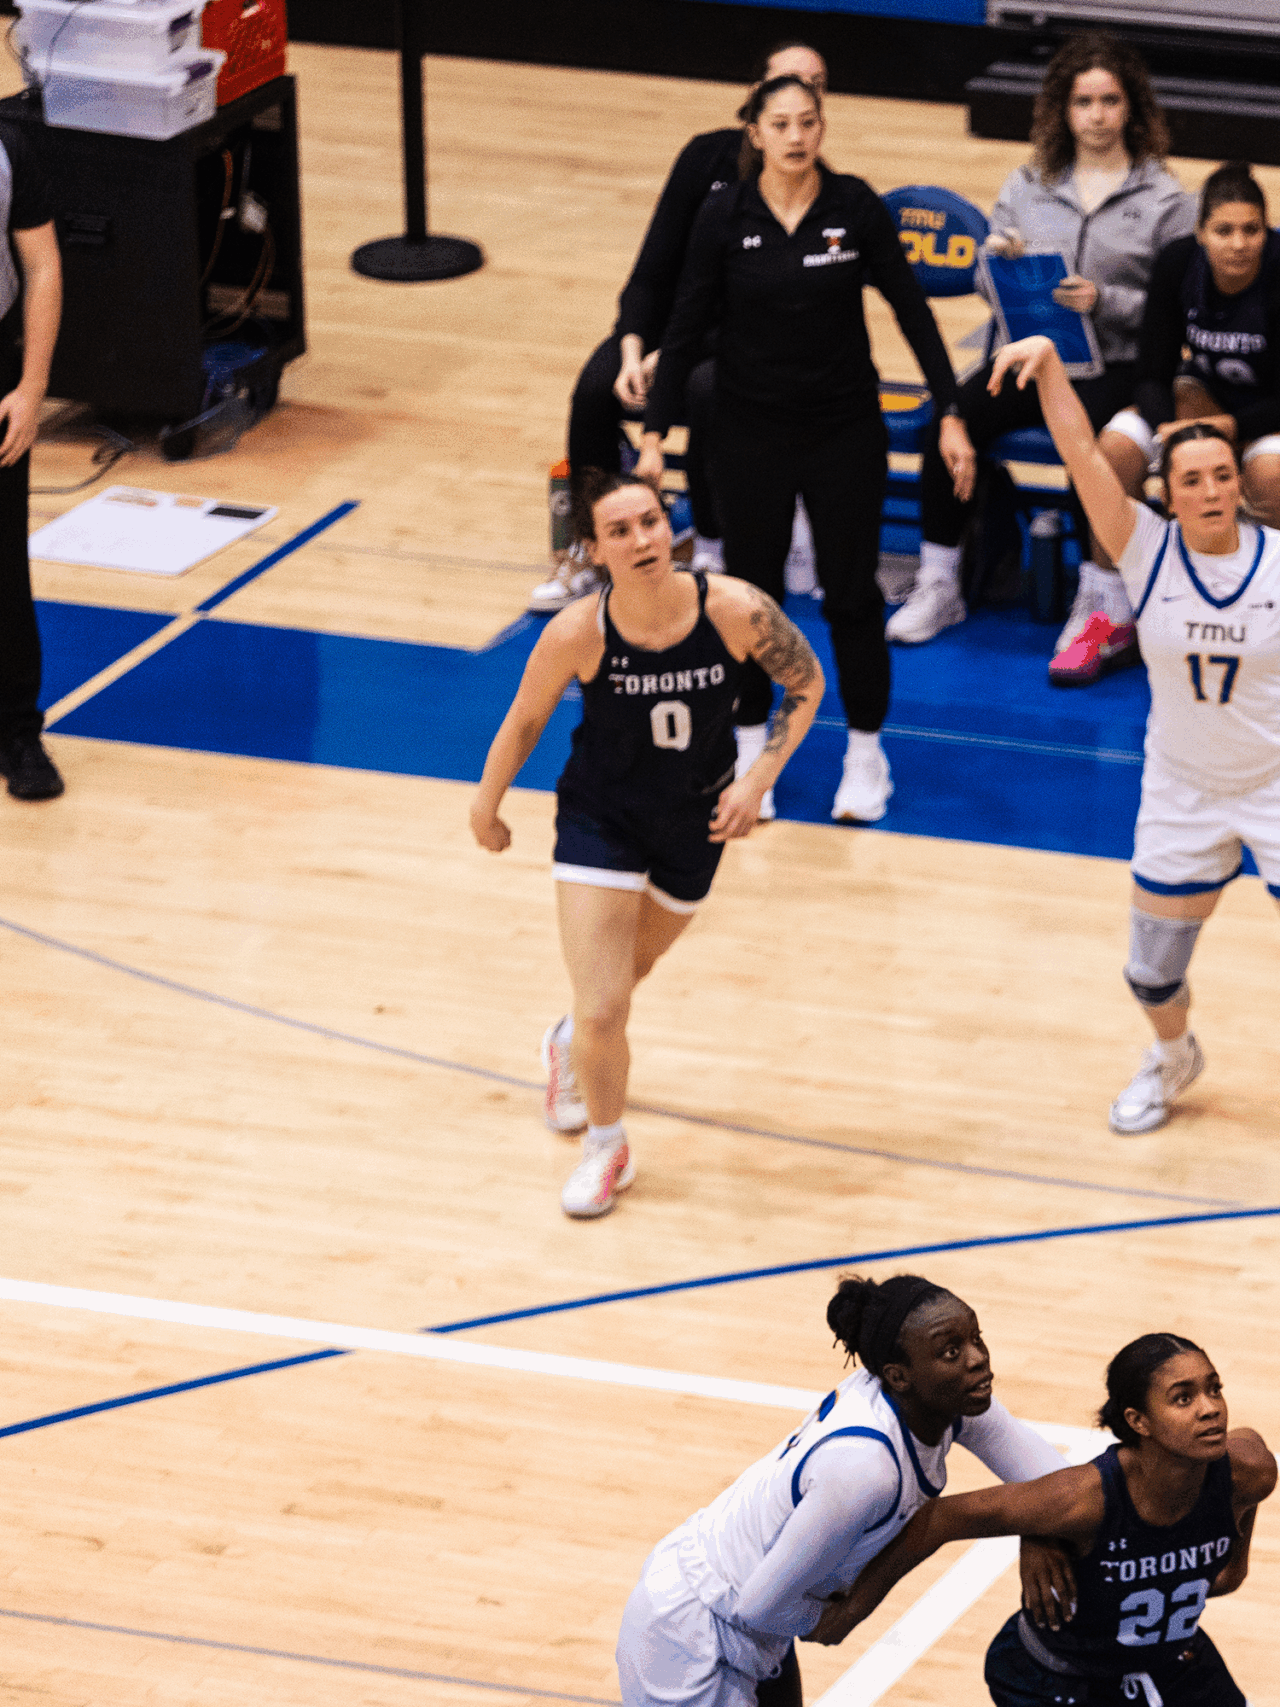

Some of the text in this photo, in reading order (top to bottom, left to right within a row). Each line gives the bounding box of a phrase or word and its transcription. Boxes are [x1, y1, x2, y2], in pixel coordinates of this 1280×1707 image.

[898, 230, 976, 269] OLD
[1185, 620, 1246, 643] TMU
[608, 663, 725, 695] TORONTO
[1185, 652, 1241, 704] 17
[650, 699, 692, 752] 0
[1100, 1535, 1231, 1583] TORONTO
[1116, 1578, 1210, 1647] 22
